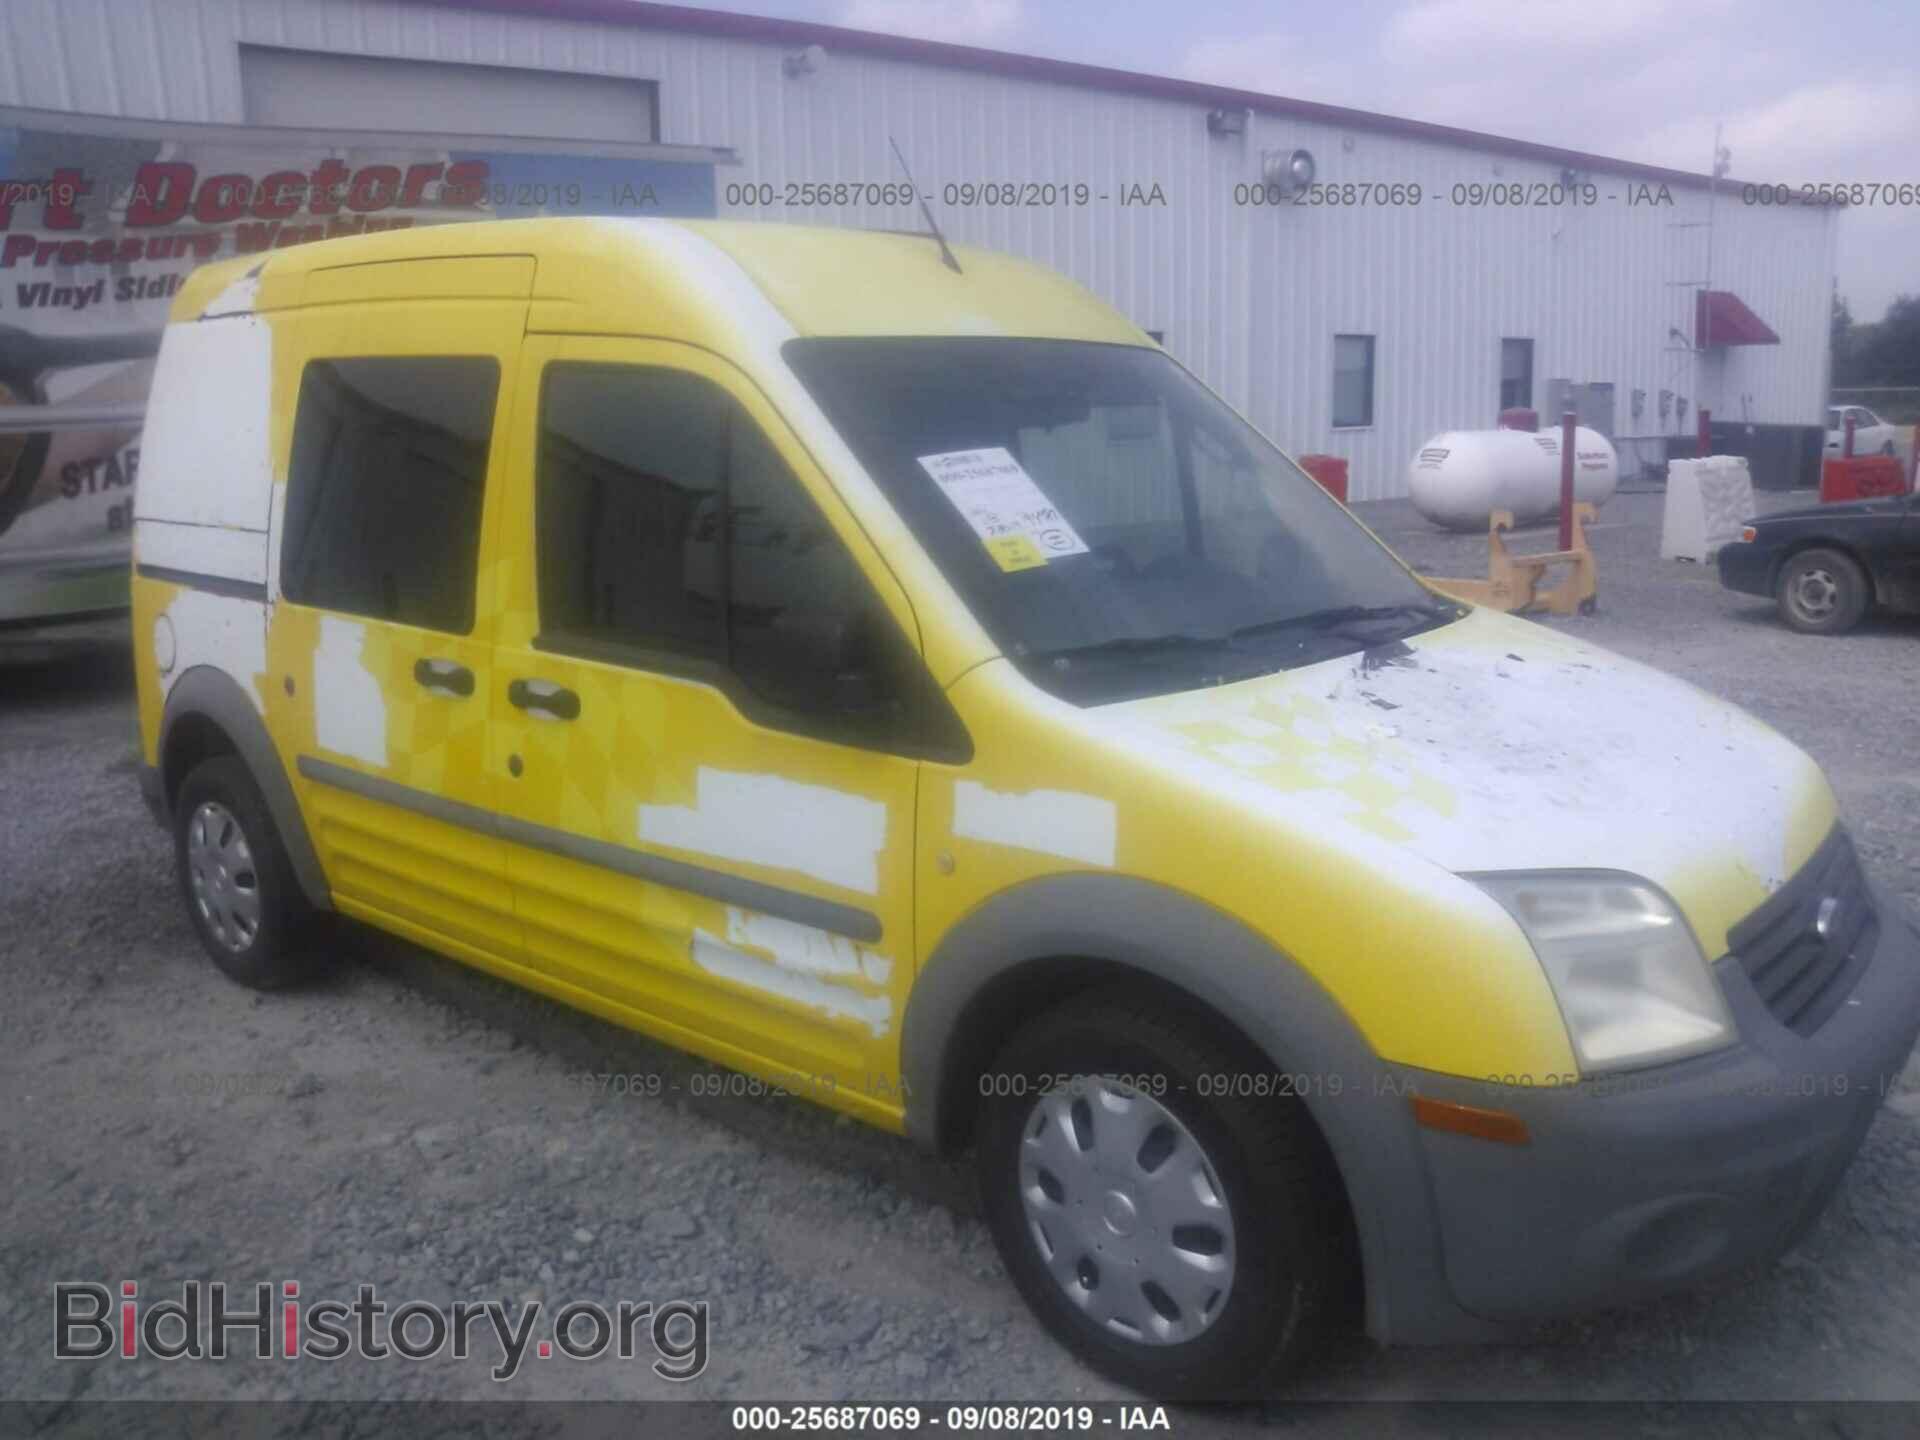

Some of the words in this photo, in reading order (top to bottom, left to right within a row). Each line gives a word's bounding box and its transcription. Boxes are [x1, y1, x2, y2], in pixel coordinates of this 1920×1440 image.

[126, 158, 490, 227] Doctors
[3, 234, 222, 268] Pressure
[16, 278, 105, 311] Vinyl
